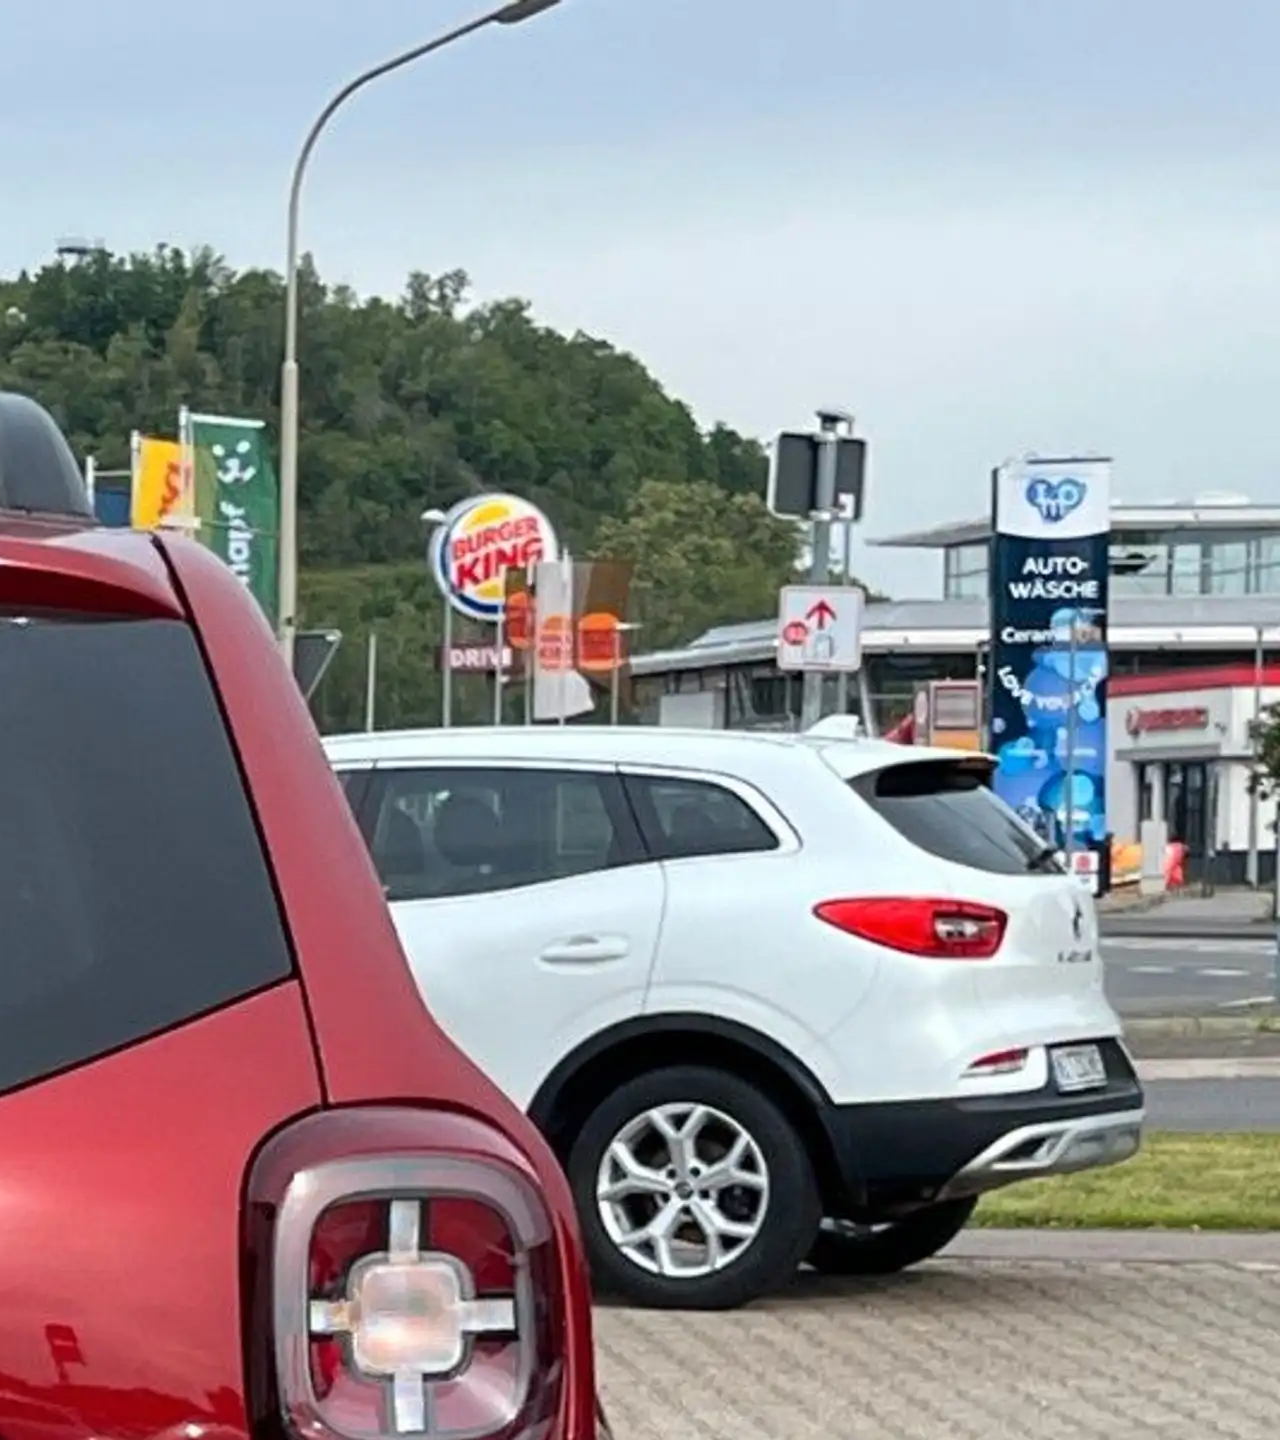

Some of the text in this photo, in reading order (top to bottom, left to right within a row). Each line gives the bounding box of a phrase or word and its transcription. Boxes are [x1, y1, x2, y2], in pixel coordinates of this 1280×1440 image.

[452, 516, 539, 560] BURGER
[456, 539, 545, 590] KING
[1022, 557, 1089, 575] AUTO-
[1009, 577, 1099, 599] WÄSCHE
